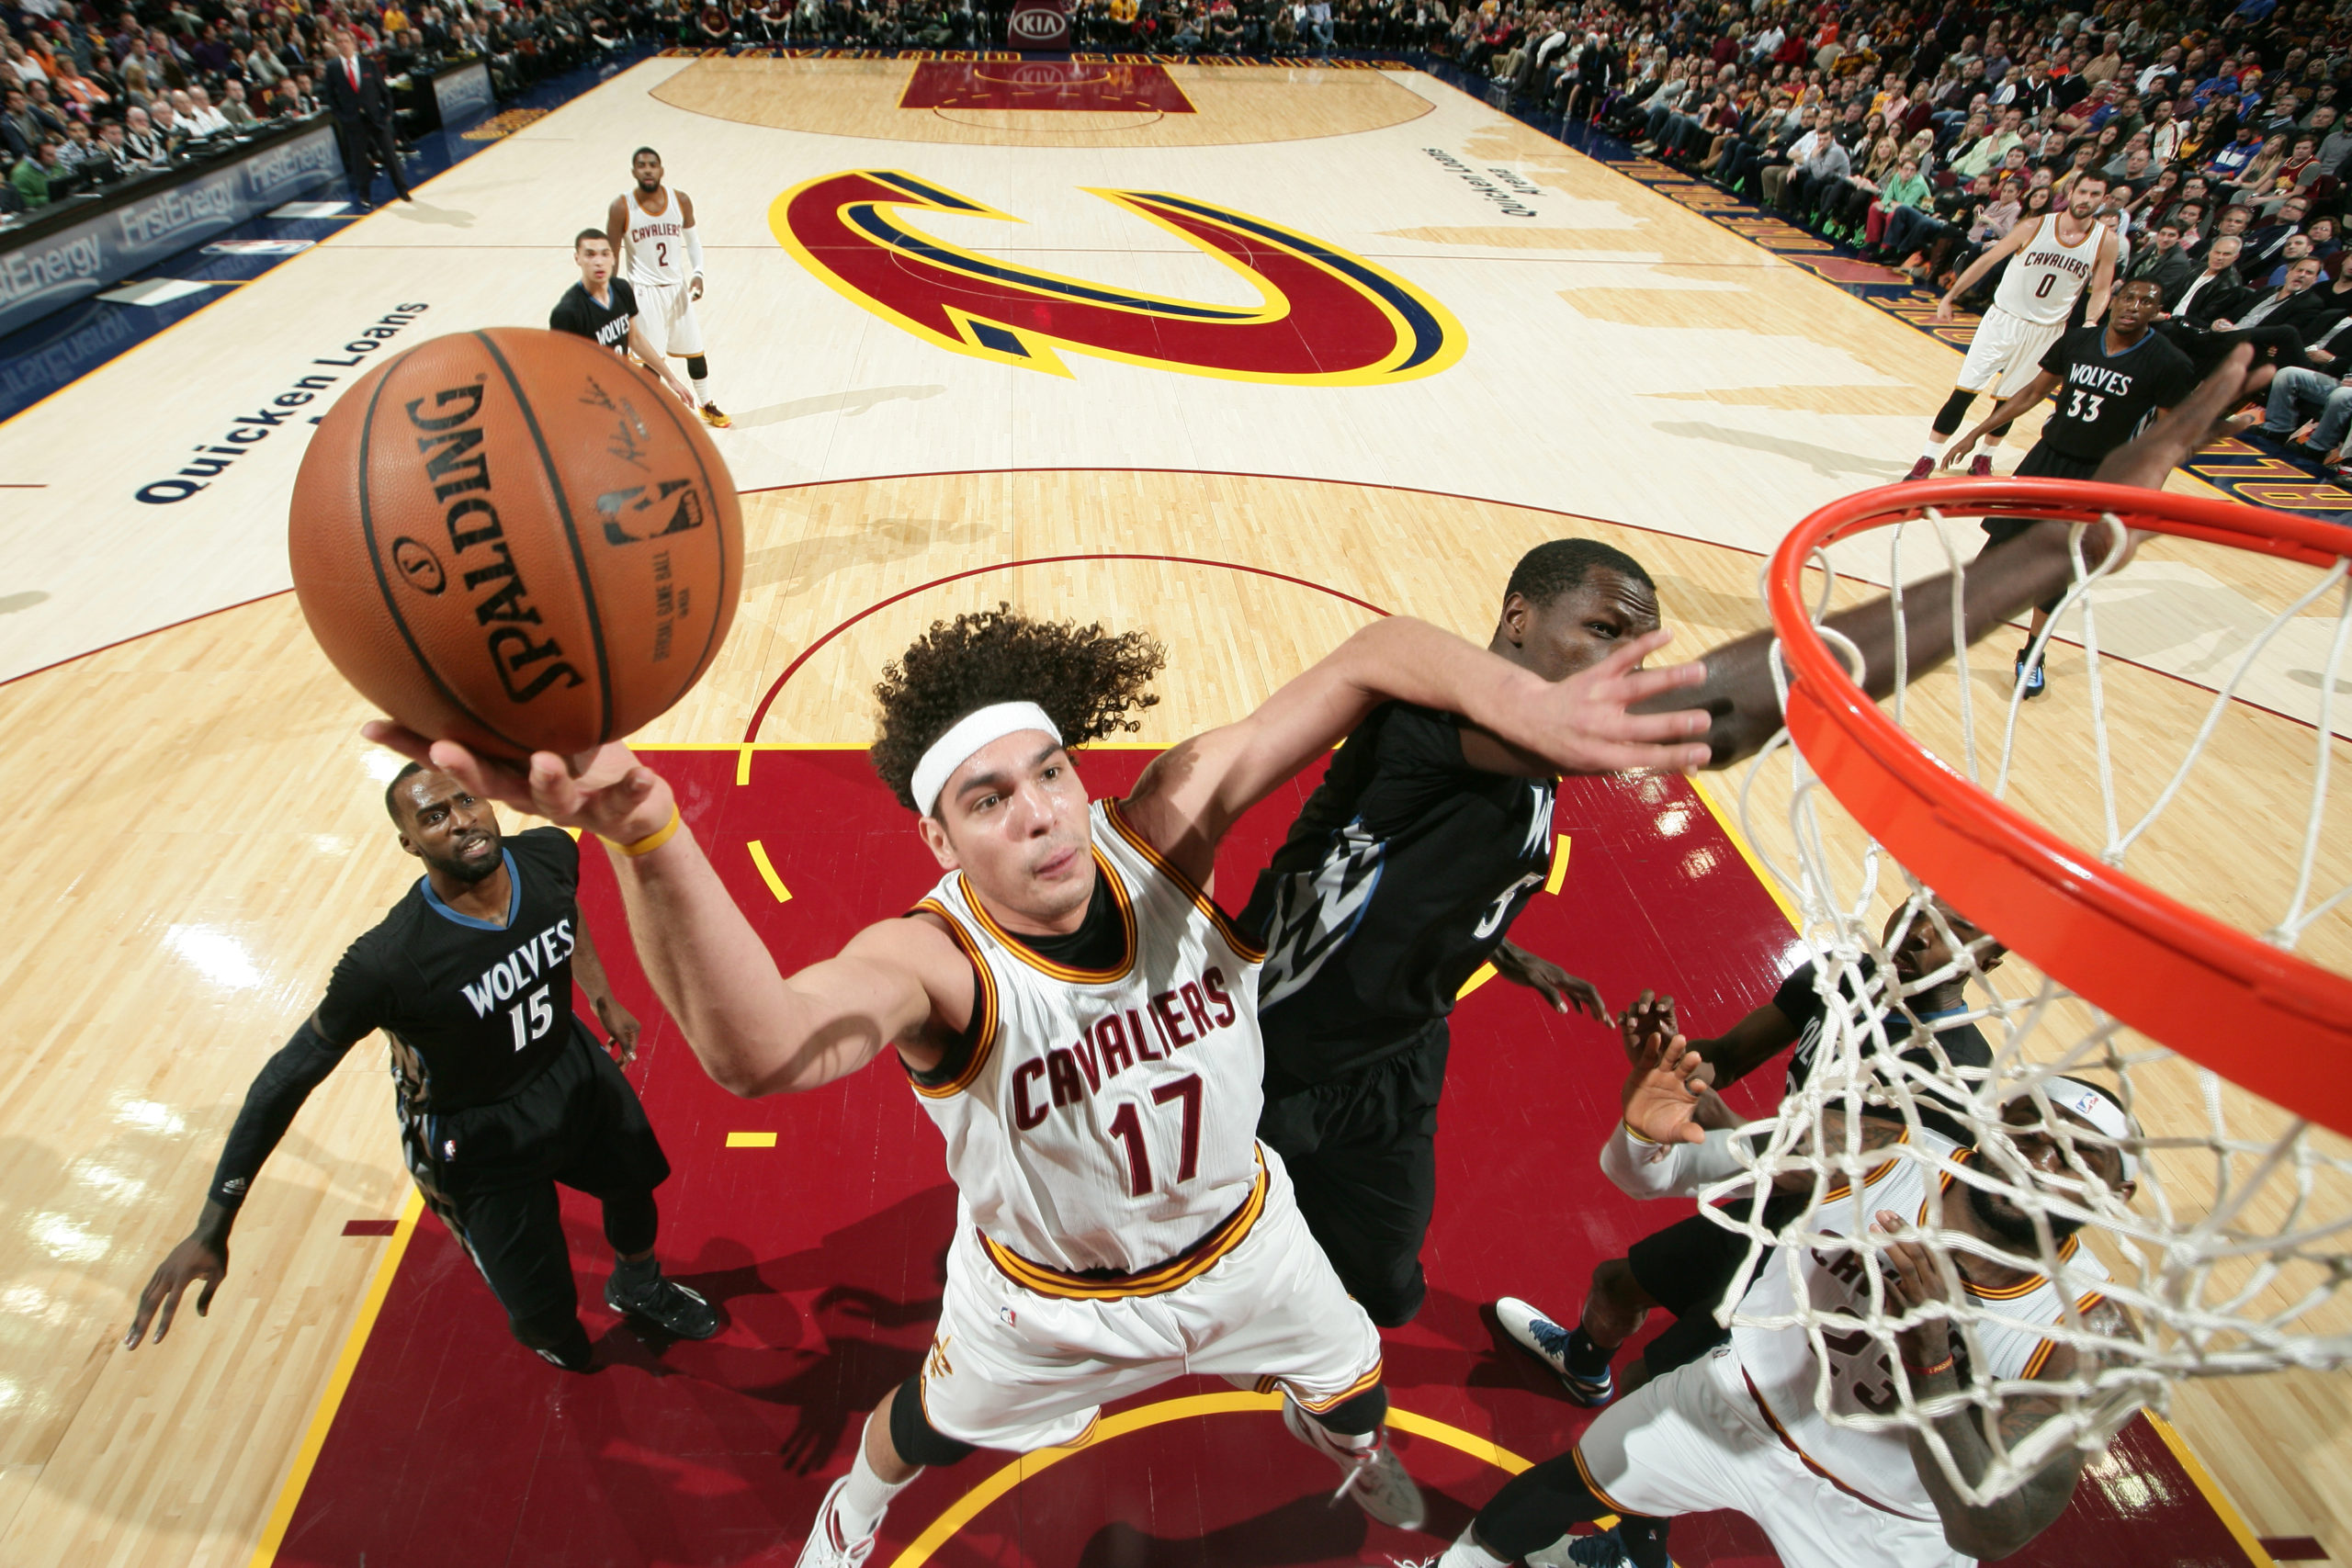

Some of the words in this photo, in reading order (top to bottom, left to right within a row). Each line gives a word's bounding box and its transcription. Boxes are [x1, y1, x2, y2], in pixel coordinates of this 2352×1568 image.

[1022, 15, 1057, 33] KIA
[657, 47, 1022, 62] CLEVELAND
[1070, 52, 1416, 71] CAVALIERS
[245, 137, 334, 194] FirstEnergy
[1487, 167, 1549, 197] Arena
[117, 176, 234, 248] FirstEnergy
[631, 223, 682, 243] CAVALIERS
[1712, 215, 1835, 252] ONE
[656, 243, 669, 267] 2
[2024, 252, 2090, 279] CAVALIERS
[2035, 274, 2057, 299] 0
[595, 312, 630, 345] WOLVES
[2069, 363, 2134, 397] WOLVES
[134, 374, 339, 505] Quicken
[311, 301, 430, 367] Loans
[2066, 389, 2105, 423] 33
[405, 383, 585, 705] SPALDING
[459, 917, 576, 1020] WOLVES
[508, 983, 554, 1052] 15
[1012, 965, 1237, 1132] CAVALIERS
[1108, 1072, 1204, 1198] 17
